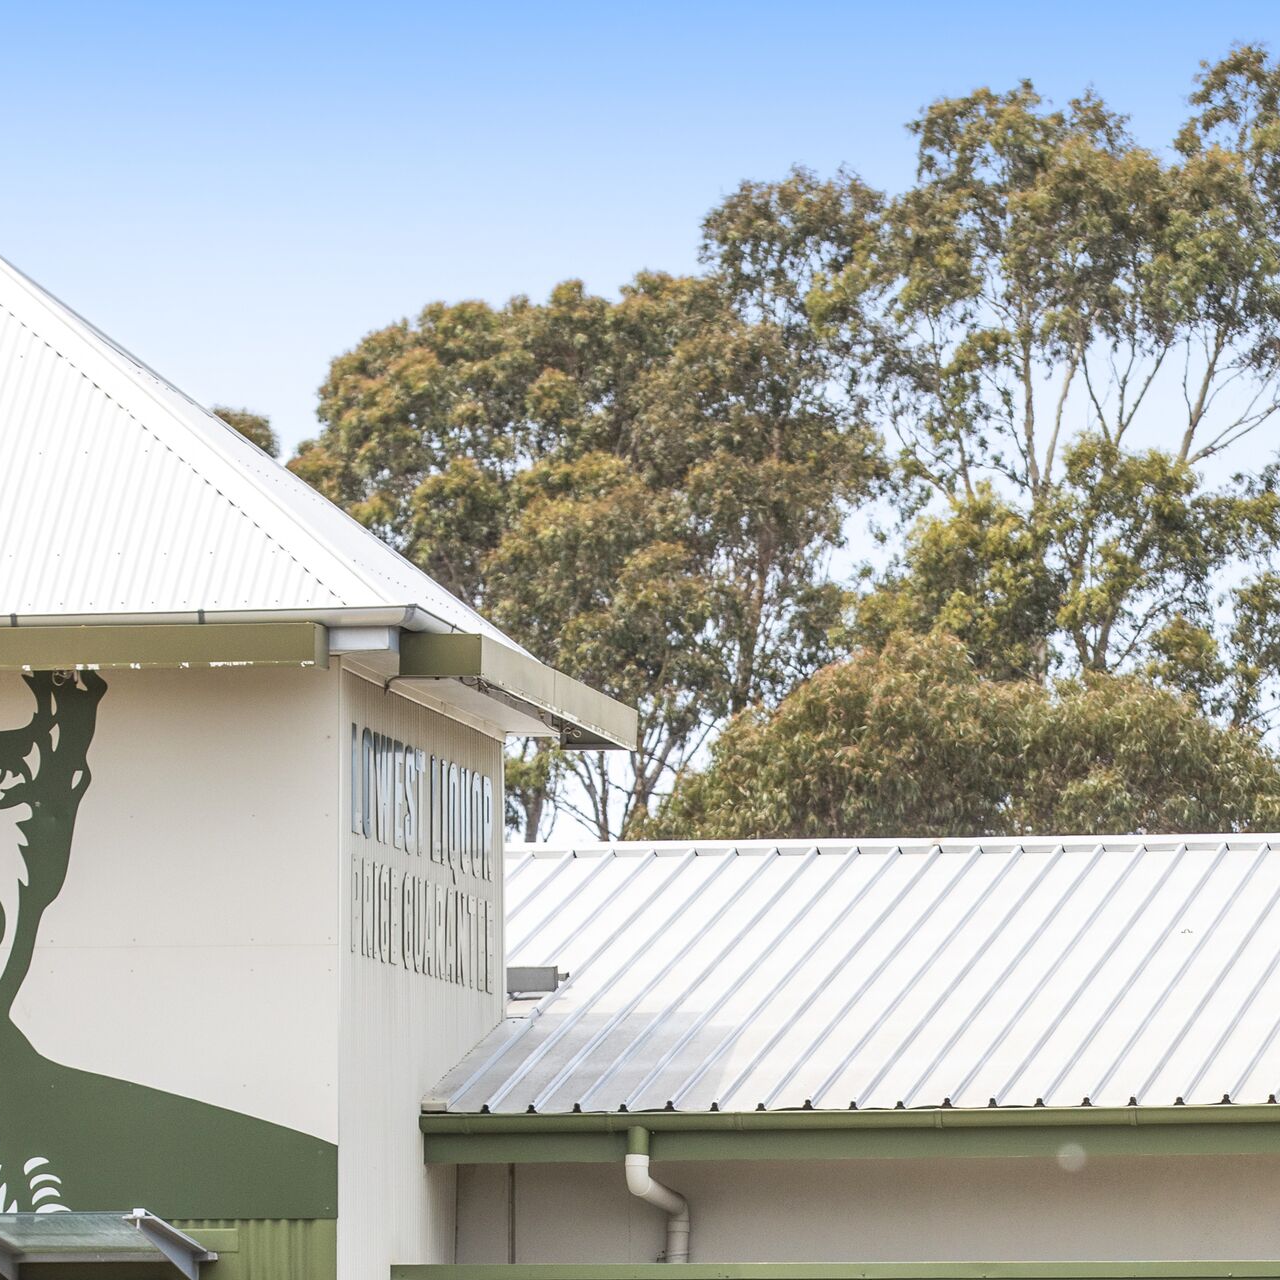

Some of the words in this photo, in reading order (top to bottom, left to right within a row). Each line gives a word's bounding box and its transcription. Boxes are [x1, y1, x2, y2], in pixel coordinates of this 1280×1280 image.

[351, 722, 426, 856] LOWEST
[430, 754, 493, 885] LIQUOR
[350, 853, 398, 966] PRICE
[402, 871, 493, 994] GUARANTEE
